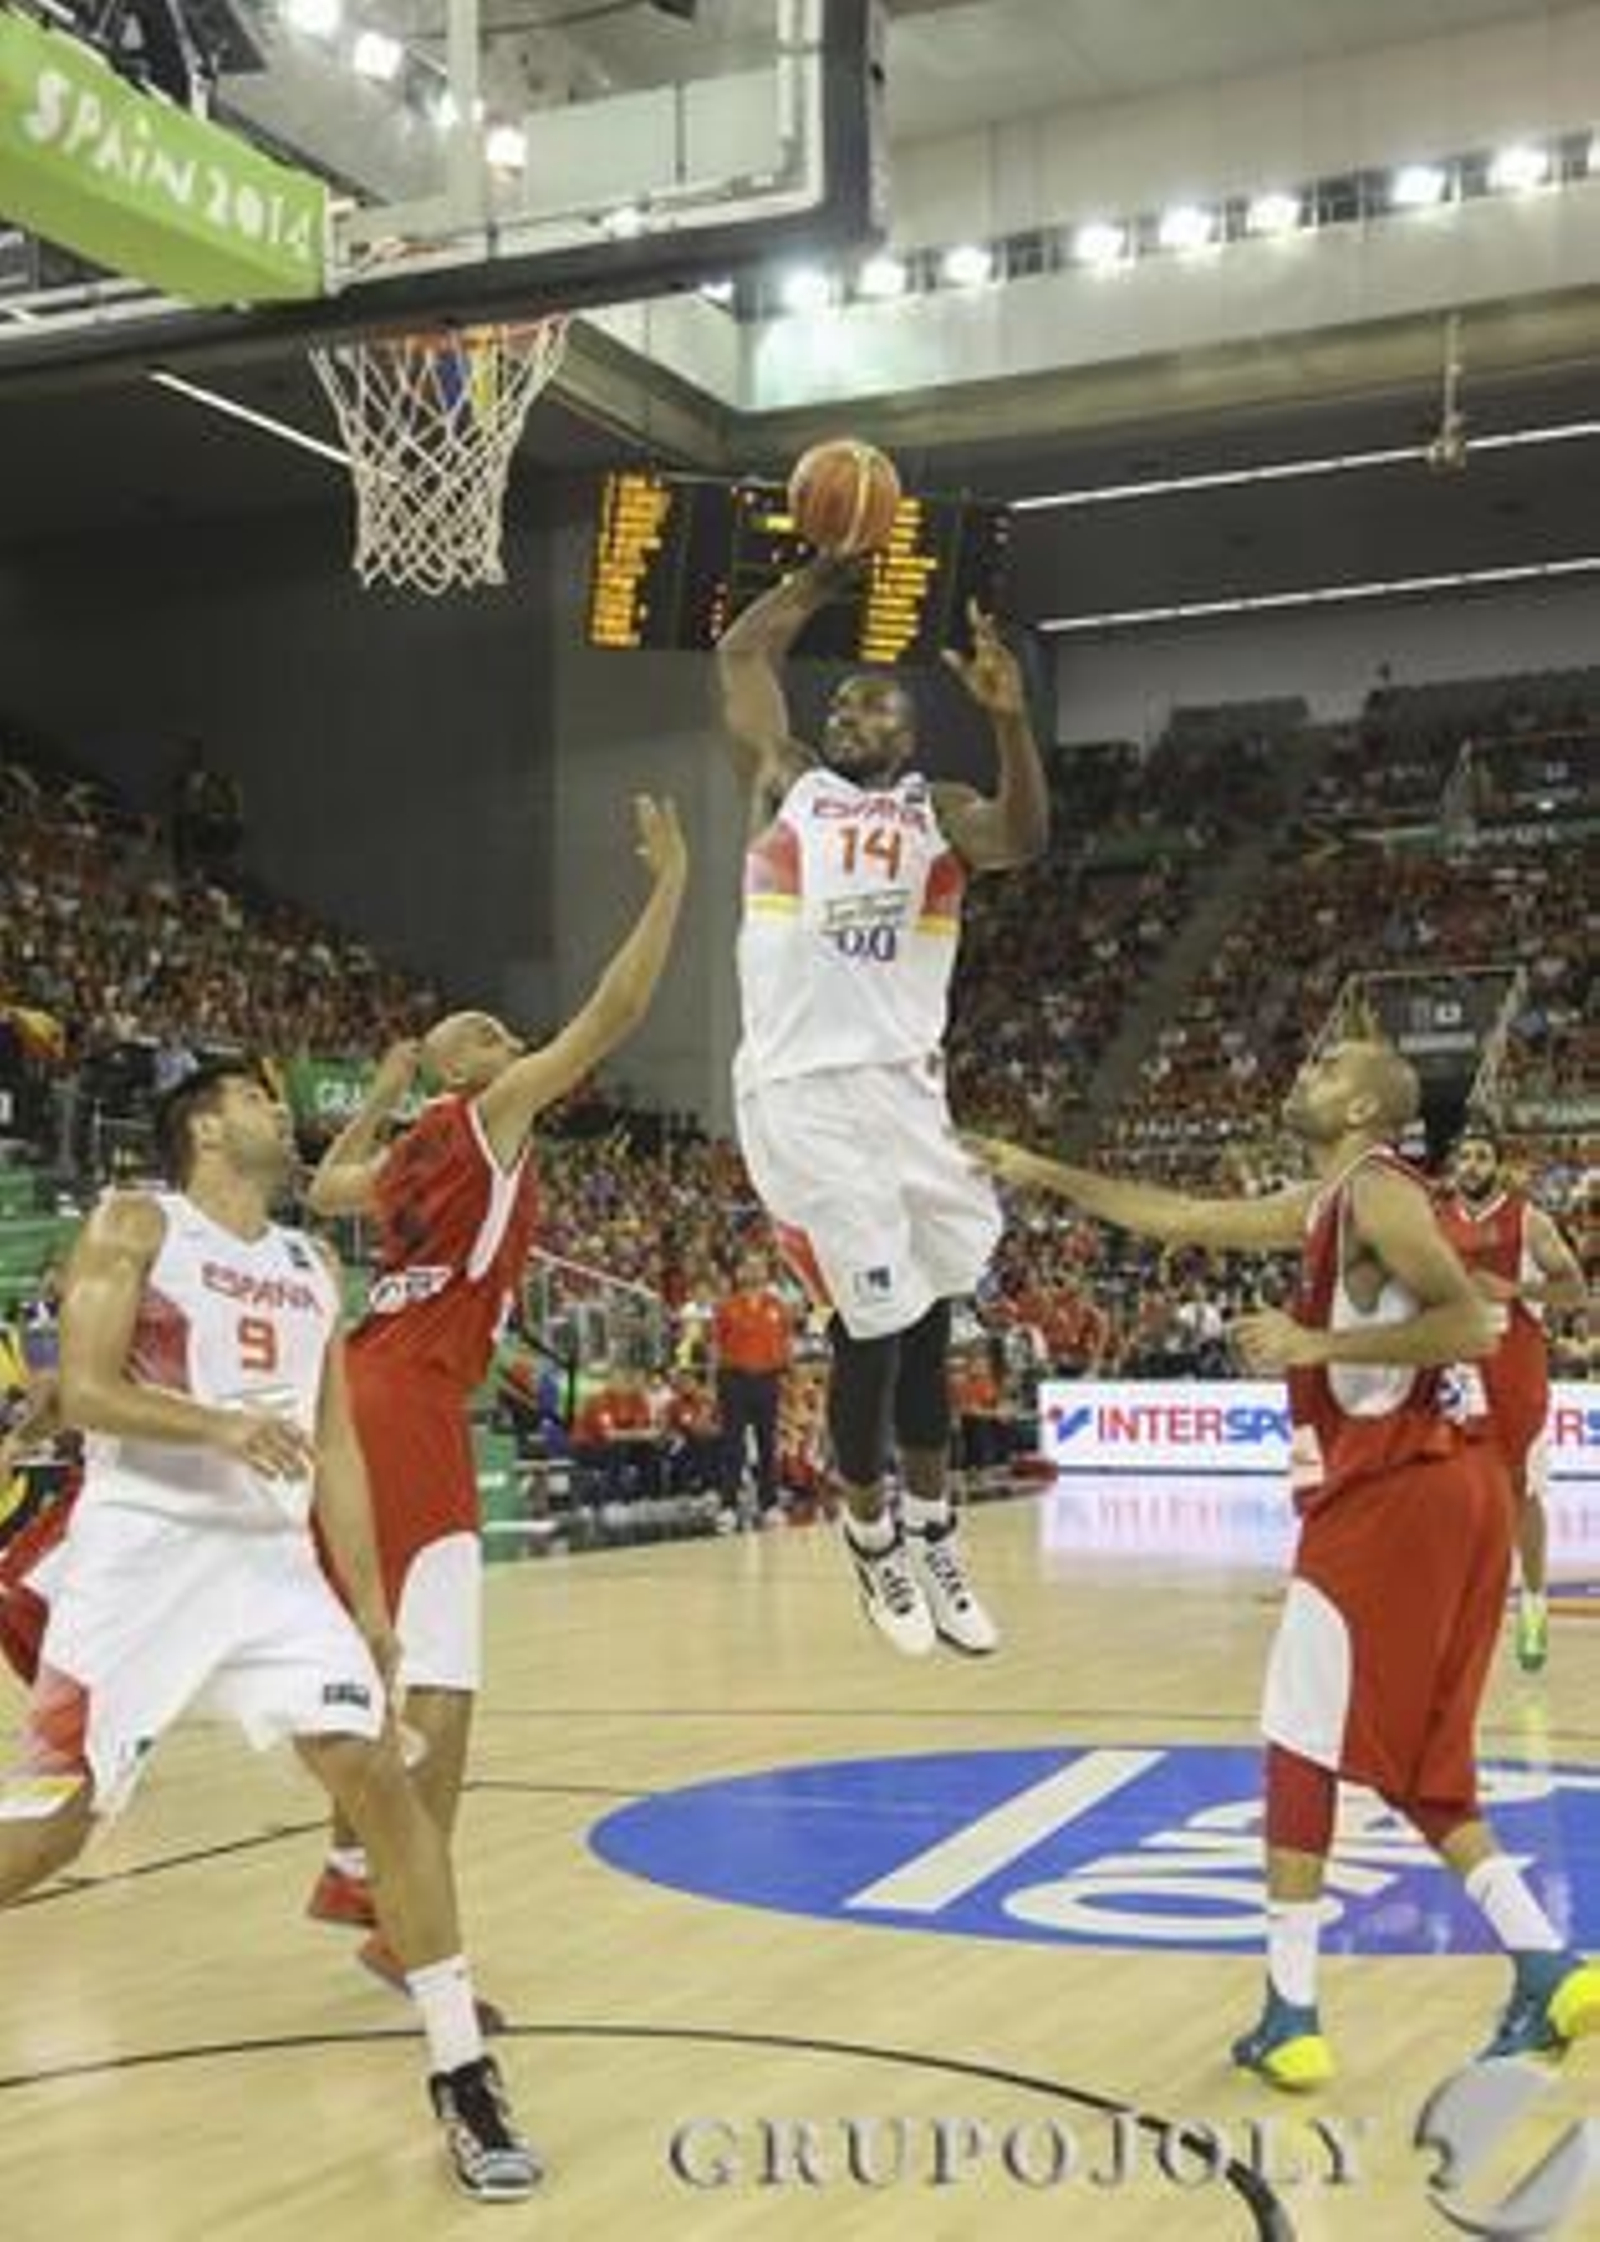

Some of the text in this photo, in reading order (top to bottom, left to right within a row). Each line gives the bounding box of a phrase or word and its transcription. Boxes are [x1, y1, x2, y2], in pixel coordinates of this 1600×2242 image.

[838, 826, 902, 880] 14
[201, 1261, 326, 1320] ESPAÑA
[237, 1316, 278, 1372] 9
